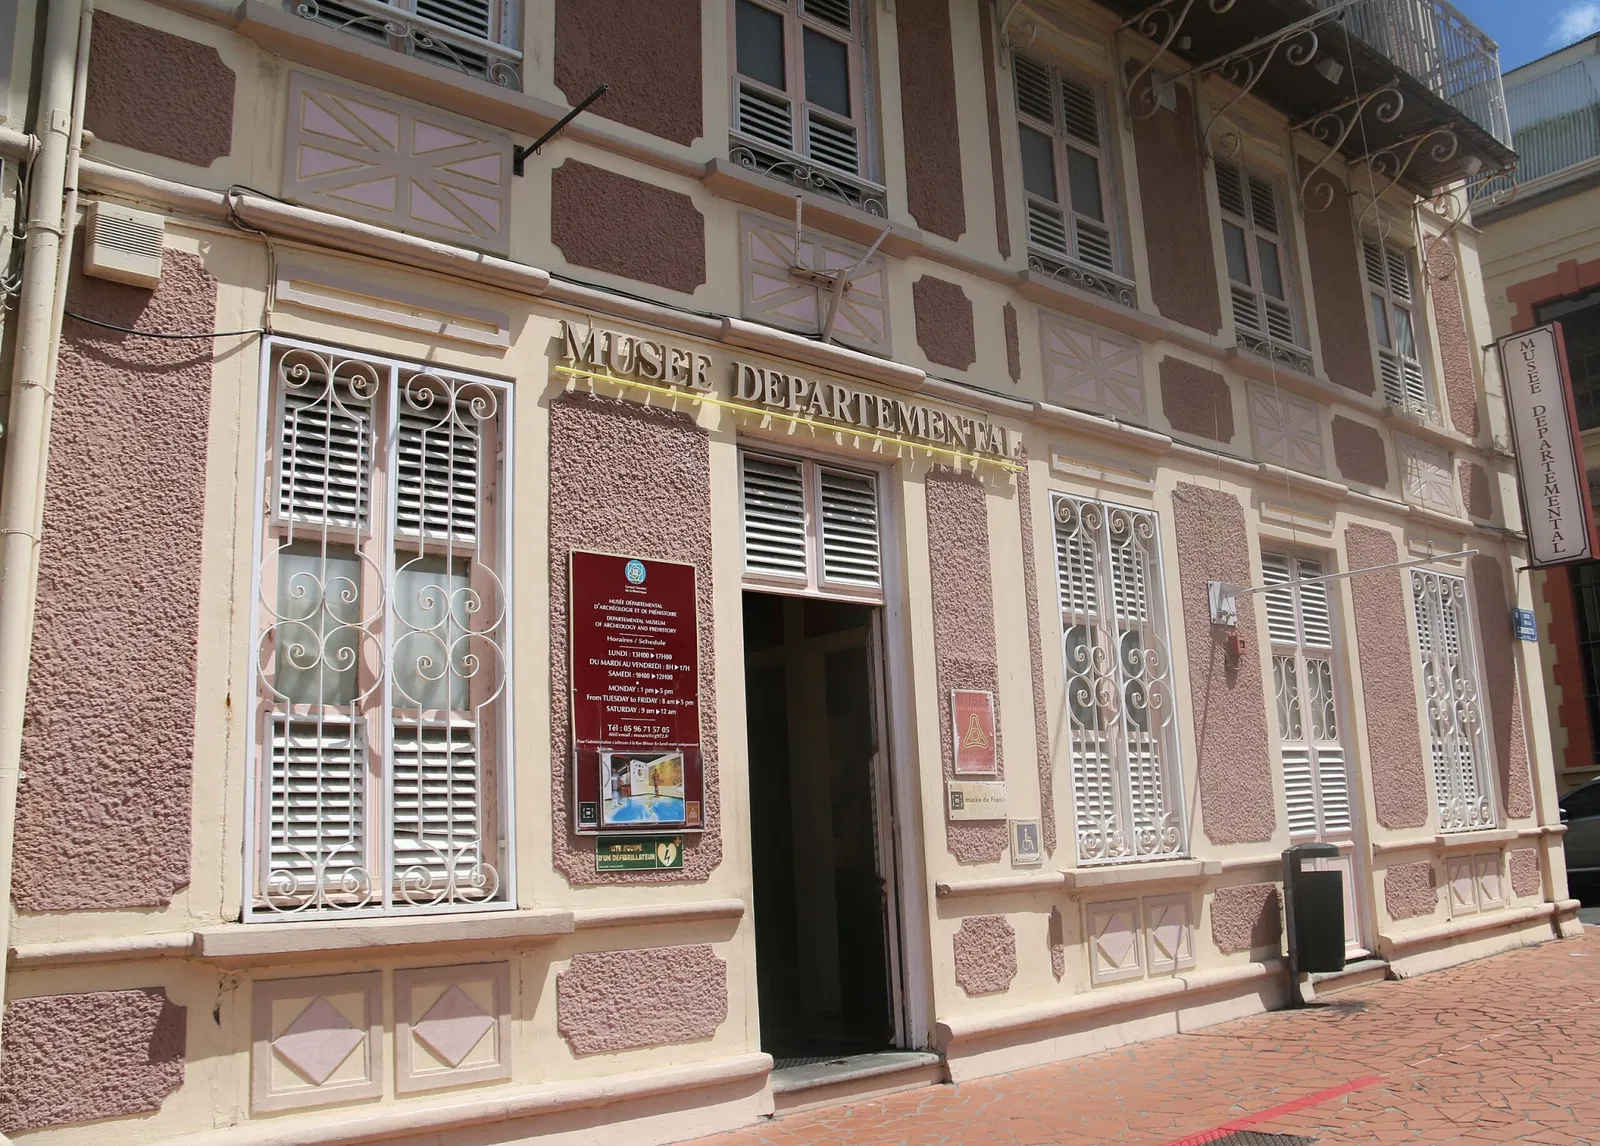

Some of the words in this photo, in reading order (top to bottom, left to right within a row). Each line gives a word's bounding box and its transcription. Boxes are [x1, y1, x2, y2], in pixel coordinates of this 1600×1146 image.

[560, 319, 713, 393] MUSEE
[731, 361, 1022, 460] DEPARTEMENTAL
[1520, 338, 1541, 395] MUSEE
[1532, 405, 1566, 554] DEPARTEMENTAL
[626, 600, 662, 608] DÉPARTEMENTAL
[648, 609, 677, 617] PRÉHISTOIRE
[632, 651, 650, 659] 13H00
[601, 659, 621, 667] MARDI
[608, 670, 631, 678] SAMEDI
[636, 671, 650, 679] 9H00
[608, 724, 618, 732] Tél
